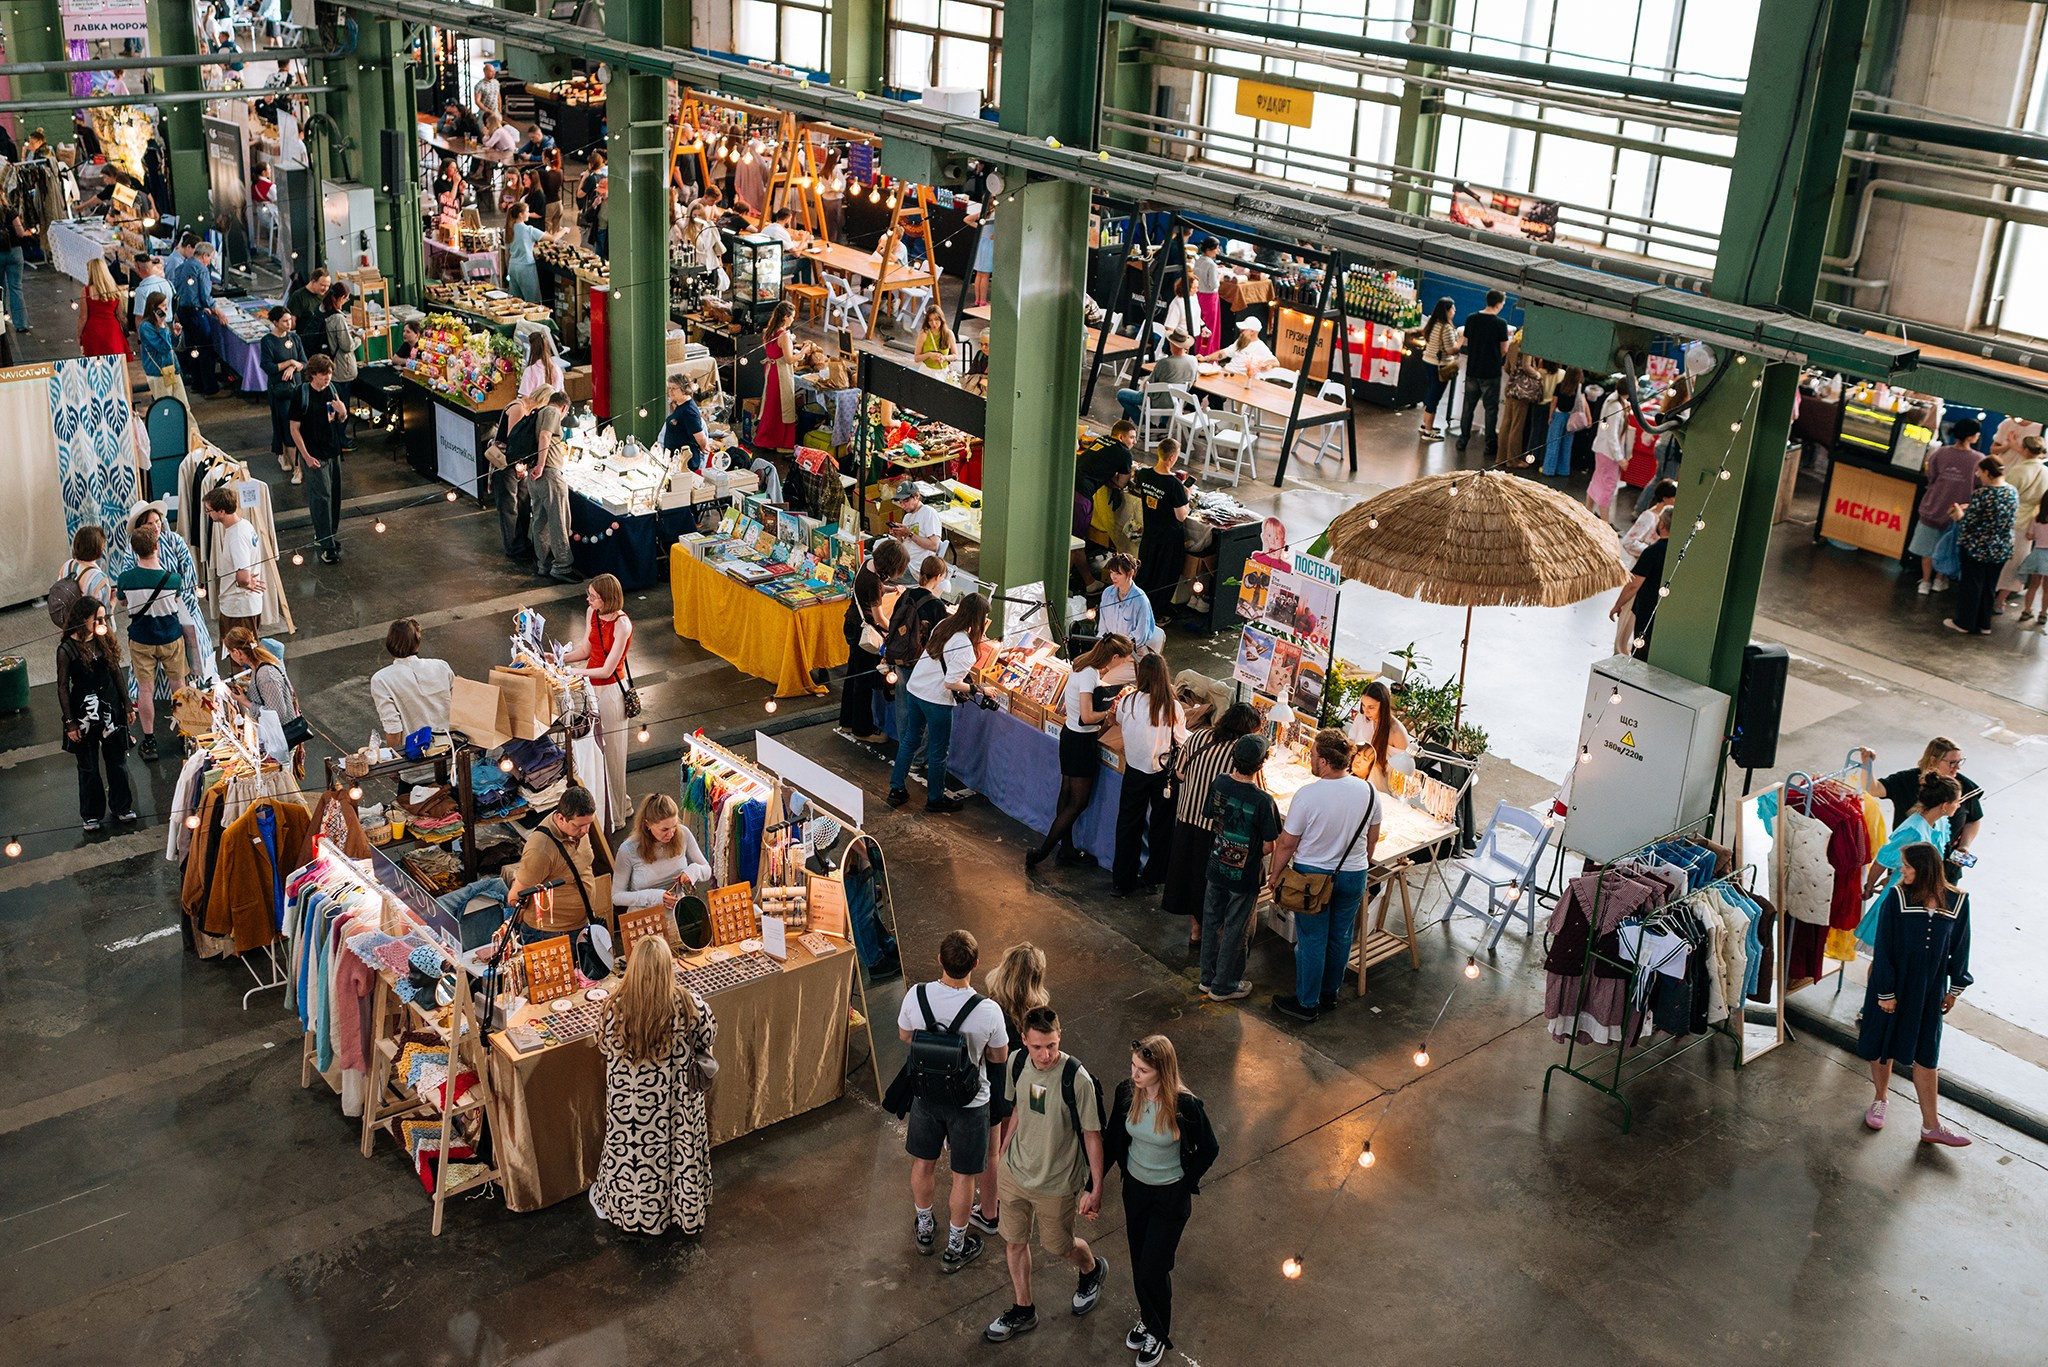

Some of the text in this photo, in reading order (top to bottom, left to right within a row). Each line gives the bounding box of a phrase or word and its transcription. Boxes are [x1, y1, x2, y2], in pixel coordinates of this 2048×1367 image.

[73, 23, 108, 32] ЛАВКА
[1257, 94, 1292, 115] ФУДКОРТ
[1285, 329, 1323, 348] ГРУЗИНАЯ
[1835, 498, 1902, 532] ИСКРА
[1295, 554, 1340, 586] ПОСТЕРЫ
[394, 868, 437, 918] MOOD
